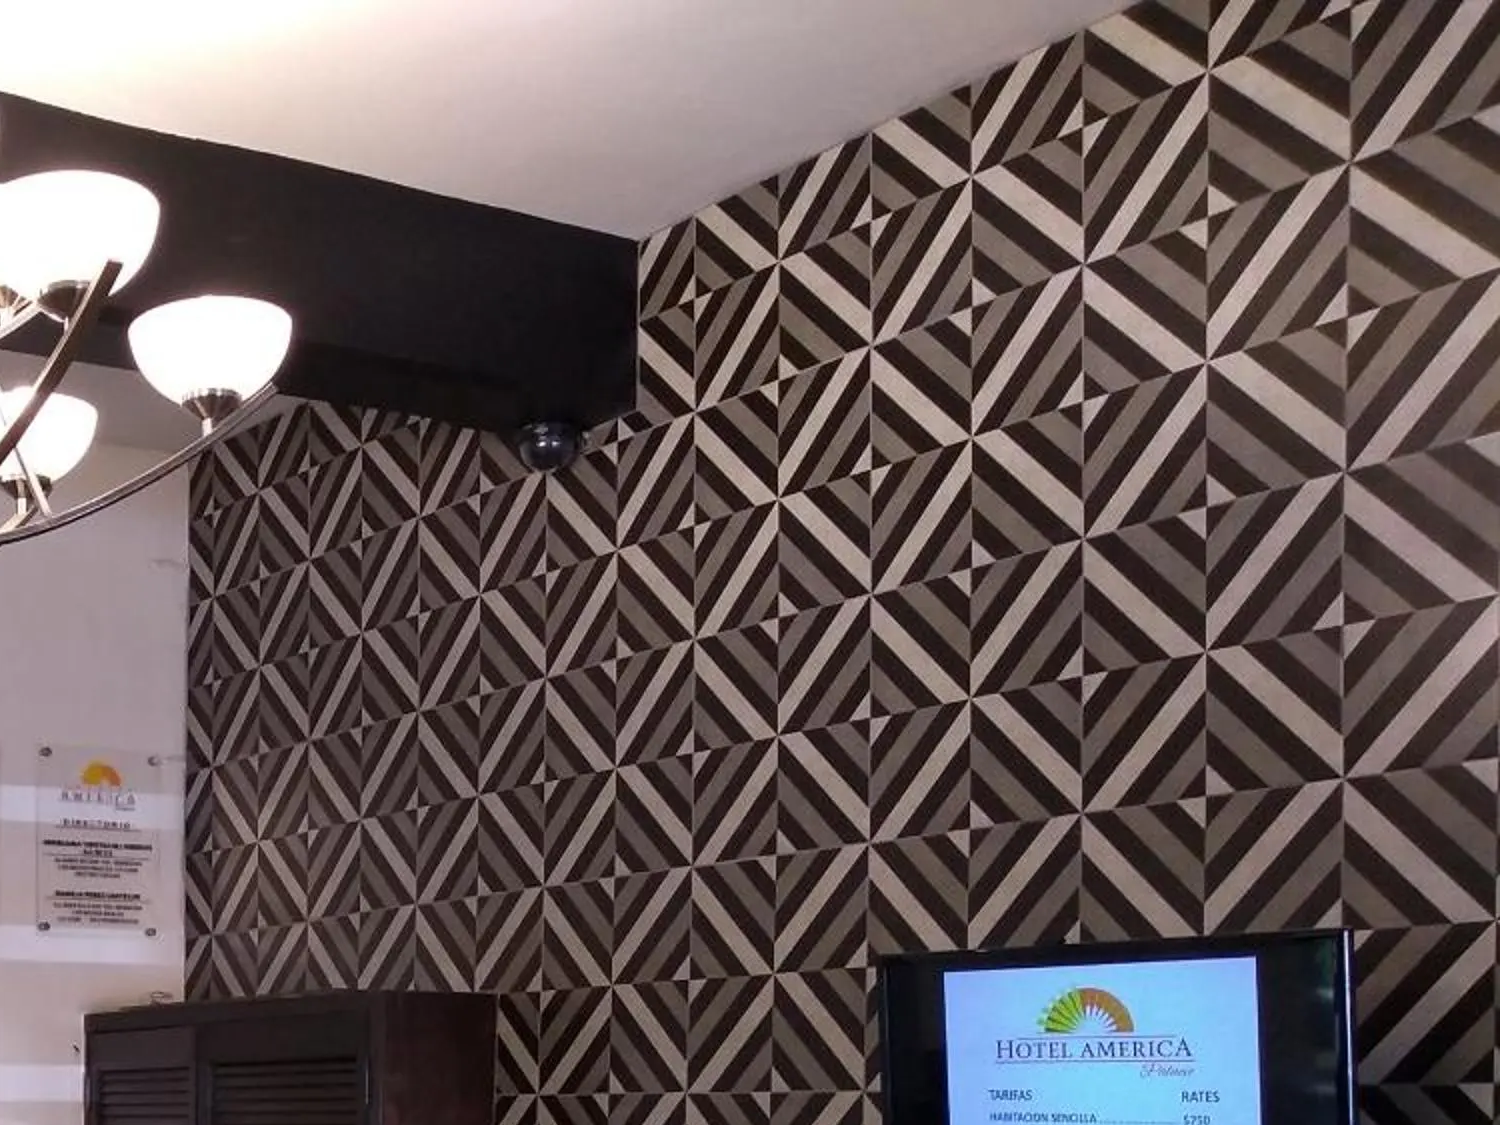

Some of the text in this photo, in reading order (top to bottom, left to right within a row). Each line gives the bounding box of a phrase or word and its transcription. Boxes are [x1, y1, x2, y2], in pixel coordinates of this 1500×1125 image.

[995, 1035, 1194, 1060] HOTEL AMERICA
[988, 1089, 1033, 1102] TARIFAS
[1181, 1090, 1221, 1104] RATES
[989, 1111, 1049, 1124] HABITACION
